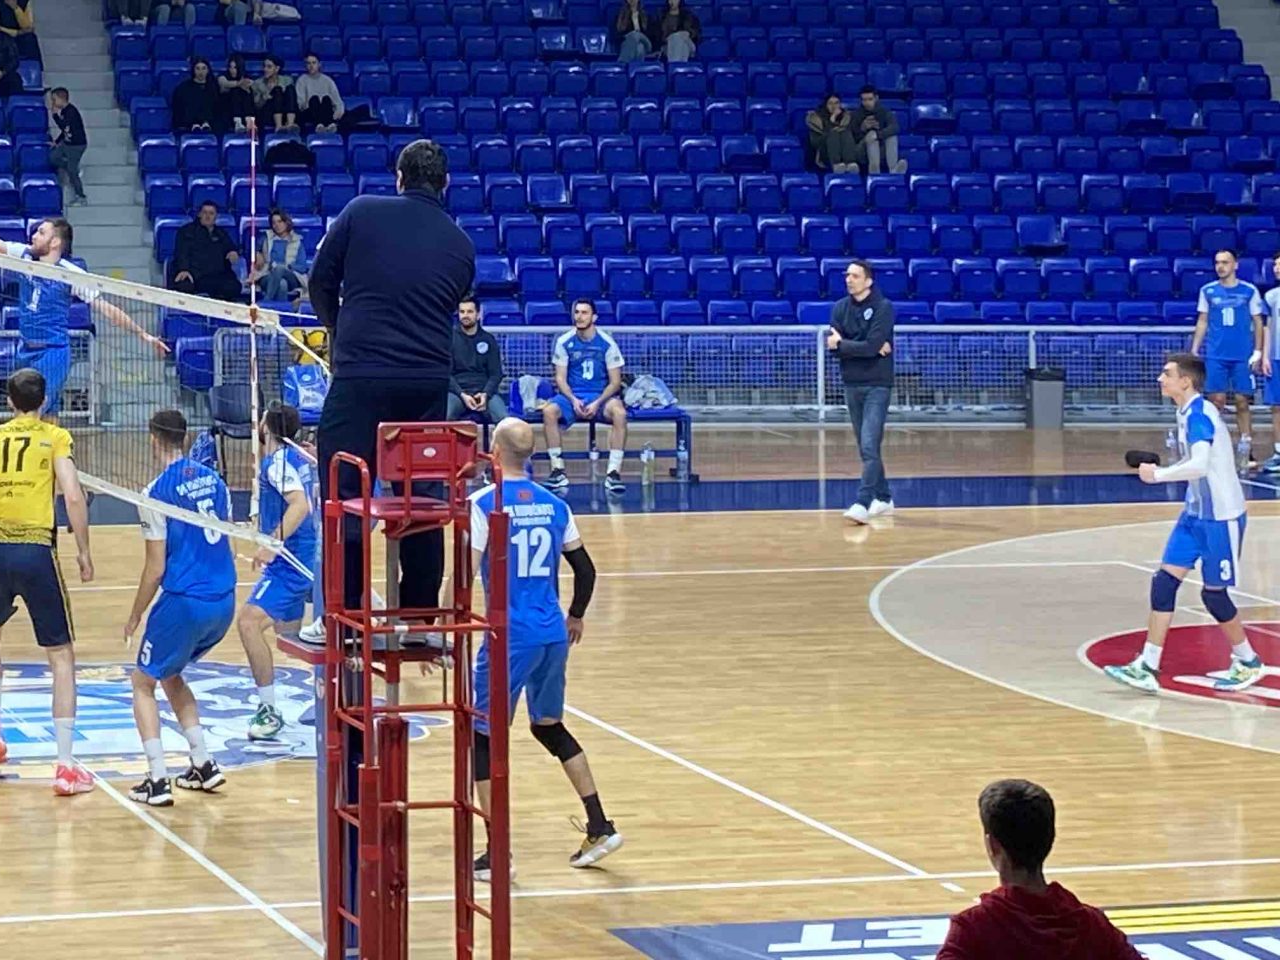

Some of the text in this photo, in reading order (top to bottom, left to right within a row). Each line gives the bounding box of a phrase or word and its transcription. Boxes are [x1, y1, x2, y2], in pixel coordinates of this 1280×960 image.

[1222, 307, 1235, 327] 10
[2, 437, 31, 473] 17
[511, 527, 552, 577] 12
[1220, 559, 1232, 581] 3
[141, 640, 153, 666] 5
